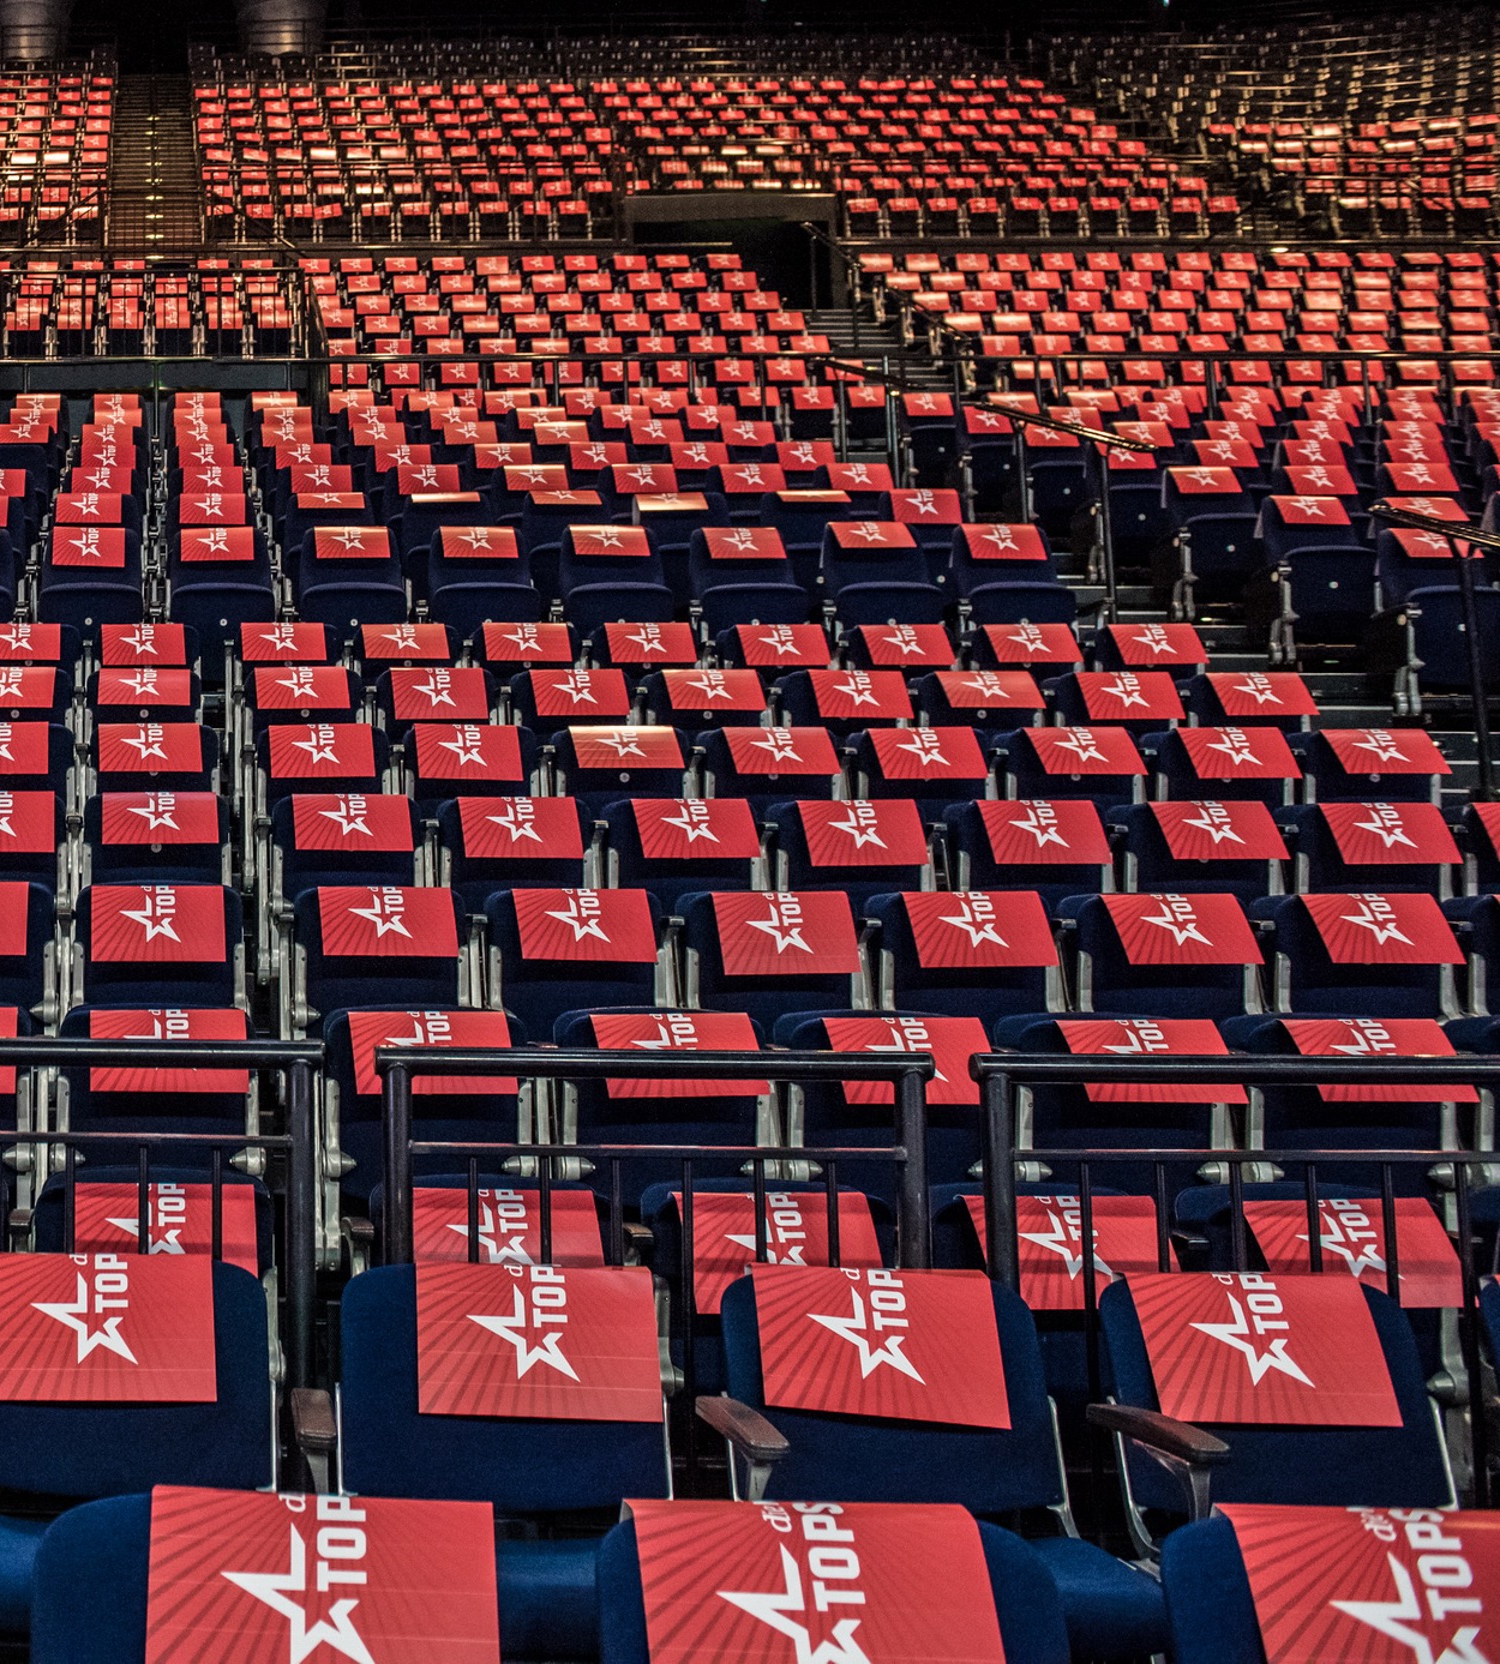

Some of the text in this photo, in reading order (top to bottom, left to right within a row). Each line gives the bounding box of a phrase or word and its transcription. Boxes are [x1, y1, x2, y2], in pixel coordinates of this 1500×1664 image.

[147, 723, 163, 742] TOP
[319, 723, 336, 746] TOP
[464, 724, 481, 747] TOP
[775, 727, 792, 744] TOP
[920, 726, 939, 748] TOP
[1074, 727, 1096, 746] TOP
[1228, 727, 1250, 748] TOP
[1371, 729, 1395, 746] TOP
[158, 792, 175, 812] TOP
[348, 794, 367, 816] TOP
[514, 797, 535, 821] TOP
[688, 798, 710, 822] TOP
[855, 799, 877, 826] TOP
[1037, 800, 1058, 826] TOP
[1206, 801, 1231, 824] TOP
[1379, 803, 1402, 826] TOP
[156, 886, 176, 916] TOP
[382, 886, 404, 914] TOP
[576, 889, 601, 917] TOP
[779, 891, 803, 926] TOP
[969, 892, 996, 920] TOP
[1169, 893, 1197, 922] TOP
[1364, 894, 1396, 920] TOP
[166, 1009, 189, 1040] TOP
[425, 1011, 452, 1043] TOP
[668, 1013, 698, 1046] TOP
[899, 1017, 933, 1050] TOP
[1133, 1019, 1169, 1051] TOP
[1360, 1019, 1397, 1050] TOP
[158, 1183, 186, 1227] TOP
[494, 1189, 529, 1233] TOP
[768, 1192, 807, 1243] TOP
[1331, 1199, 1378, 1241] TOP
[95, 1253, 129, 1313] TOP
[530, 1265, 568, 1328] TOP
[867, 1268, 909, 1331] TOP
[1240, 1272, 1289, 1335] TOP
[317, 1494, 367, 1591] TOP
